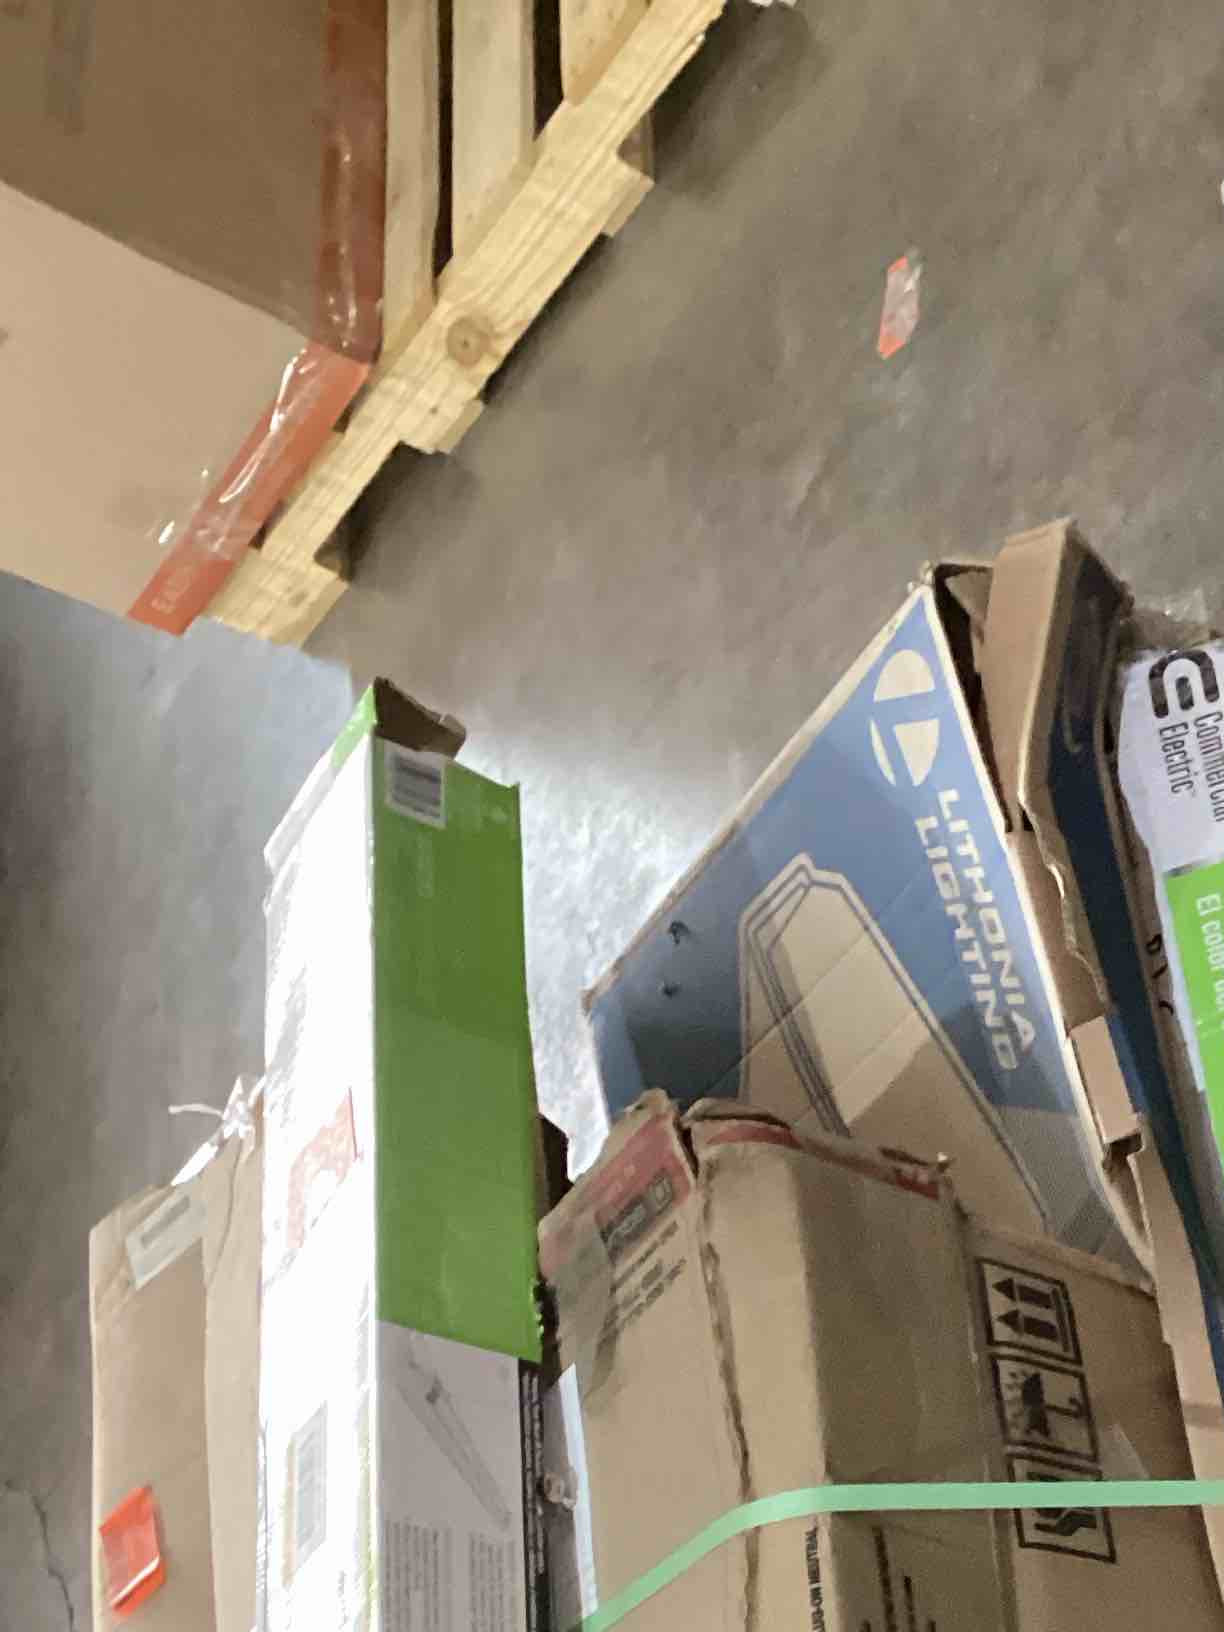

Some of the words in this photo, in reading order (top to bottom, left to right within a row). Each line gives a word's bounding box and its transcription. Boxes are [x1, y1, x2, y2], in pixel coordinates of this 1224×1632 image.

[1157, 721, 1195, 796] Electric
[916, 816, 1017, 1070] LIGHTING
[939, 790, 1036, 1051] LITHONIA
[1193, 893, 1223, 918] El
[805, 1528, 822, 1584] NEUTRAL
